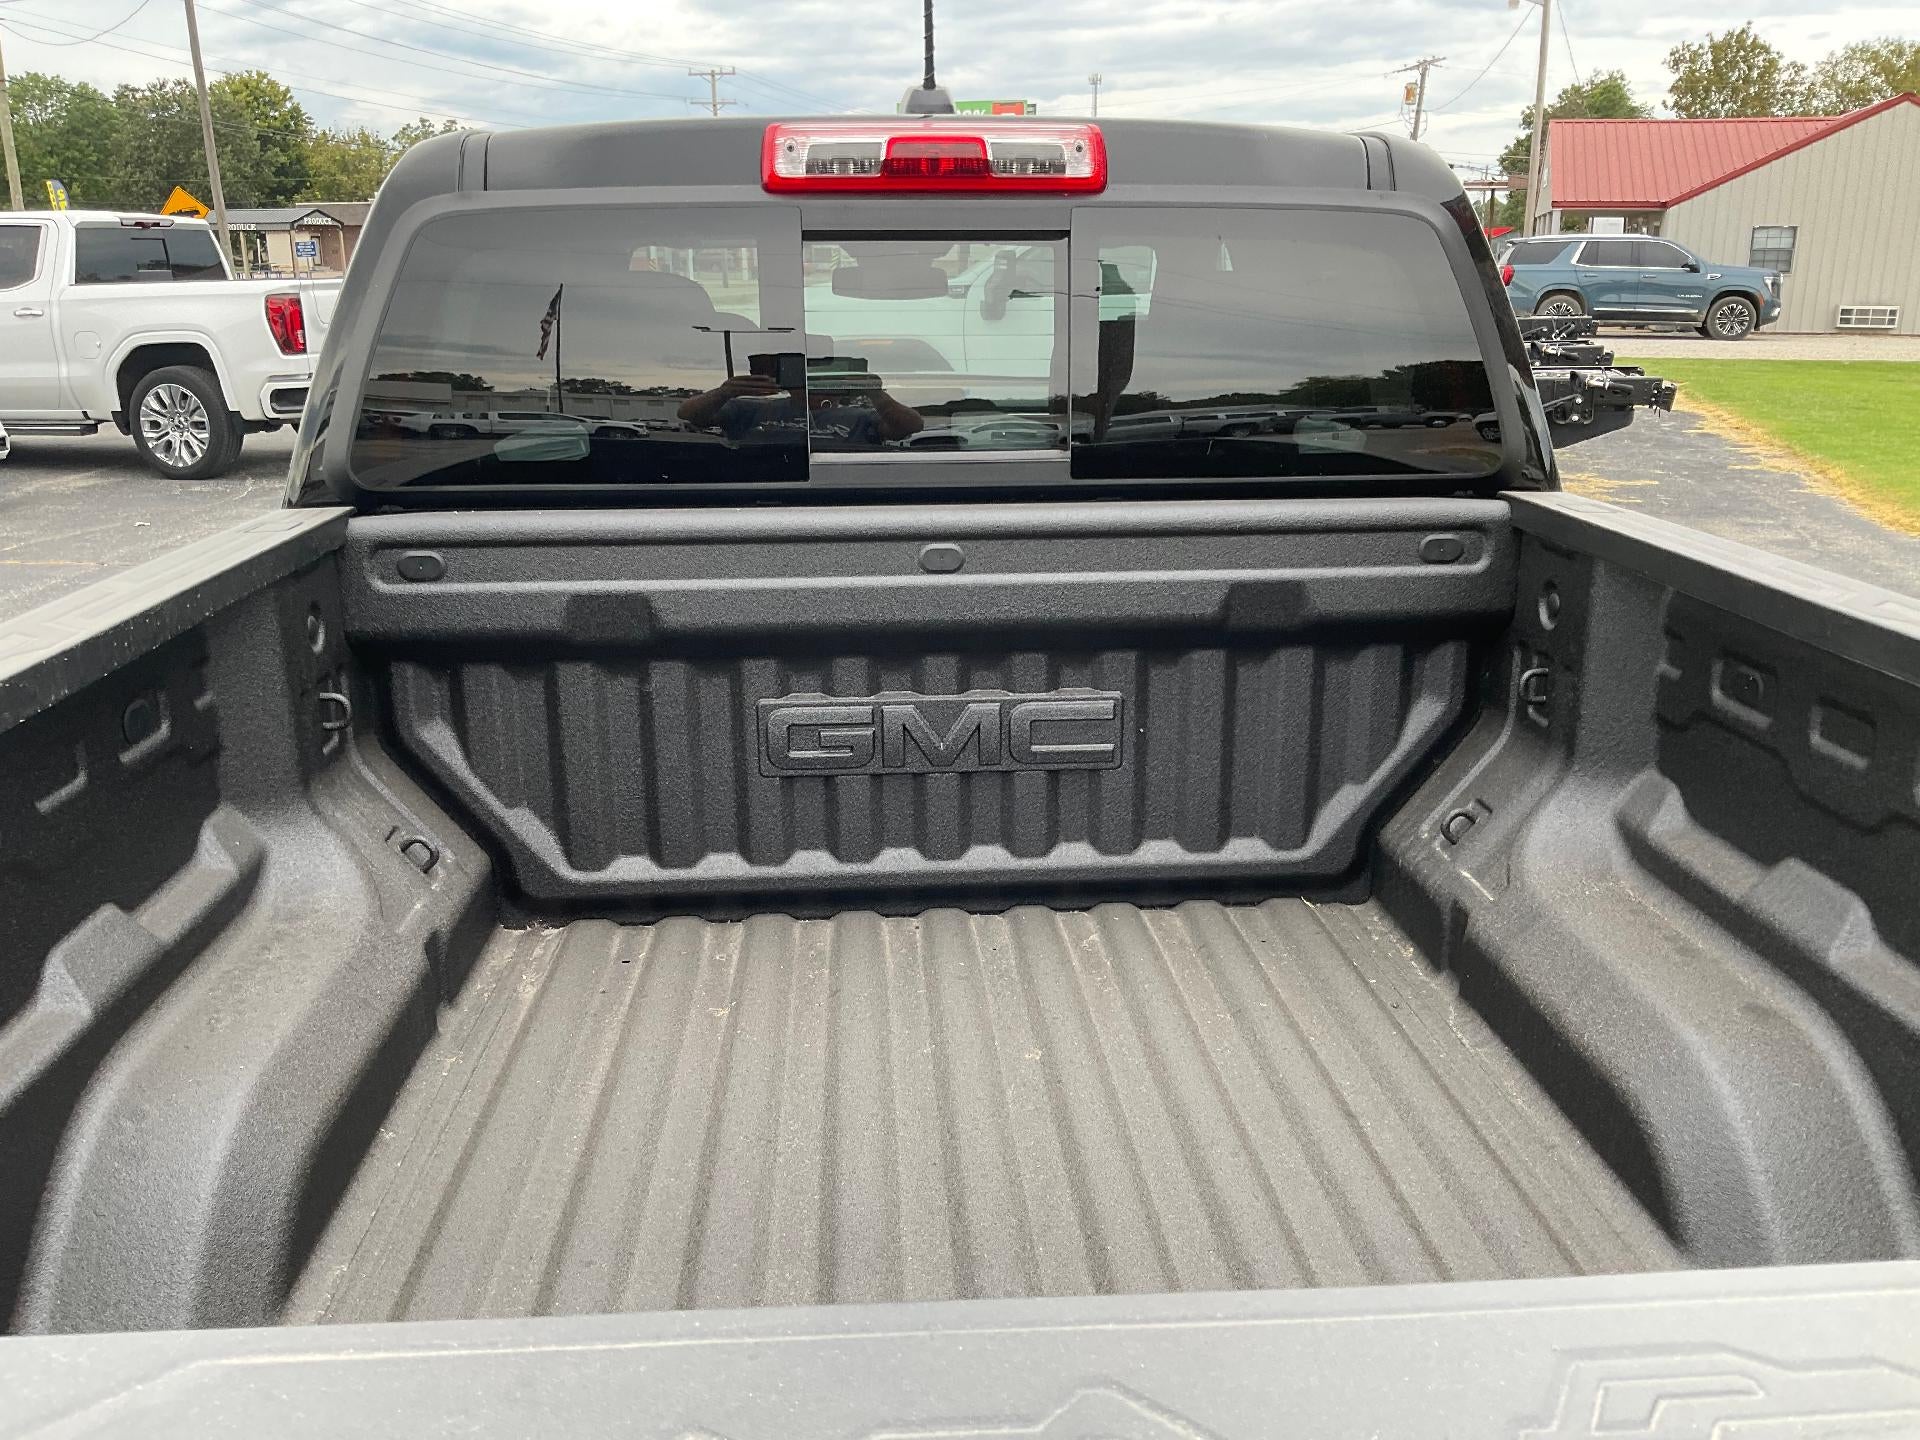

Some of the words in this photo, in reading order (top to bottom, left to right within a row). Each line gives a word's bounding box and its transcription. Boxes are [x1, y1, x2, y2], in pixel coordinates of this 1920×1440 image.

[304, 217, 332, 225] PRODUCE
[227, 223, 257, 231] RODUCE
[767, 701, 1116, 770] GMC
